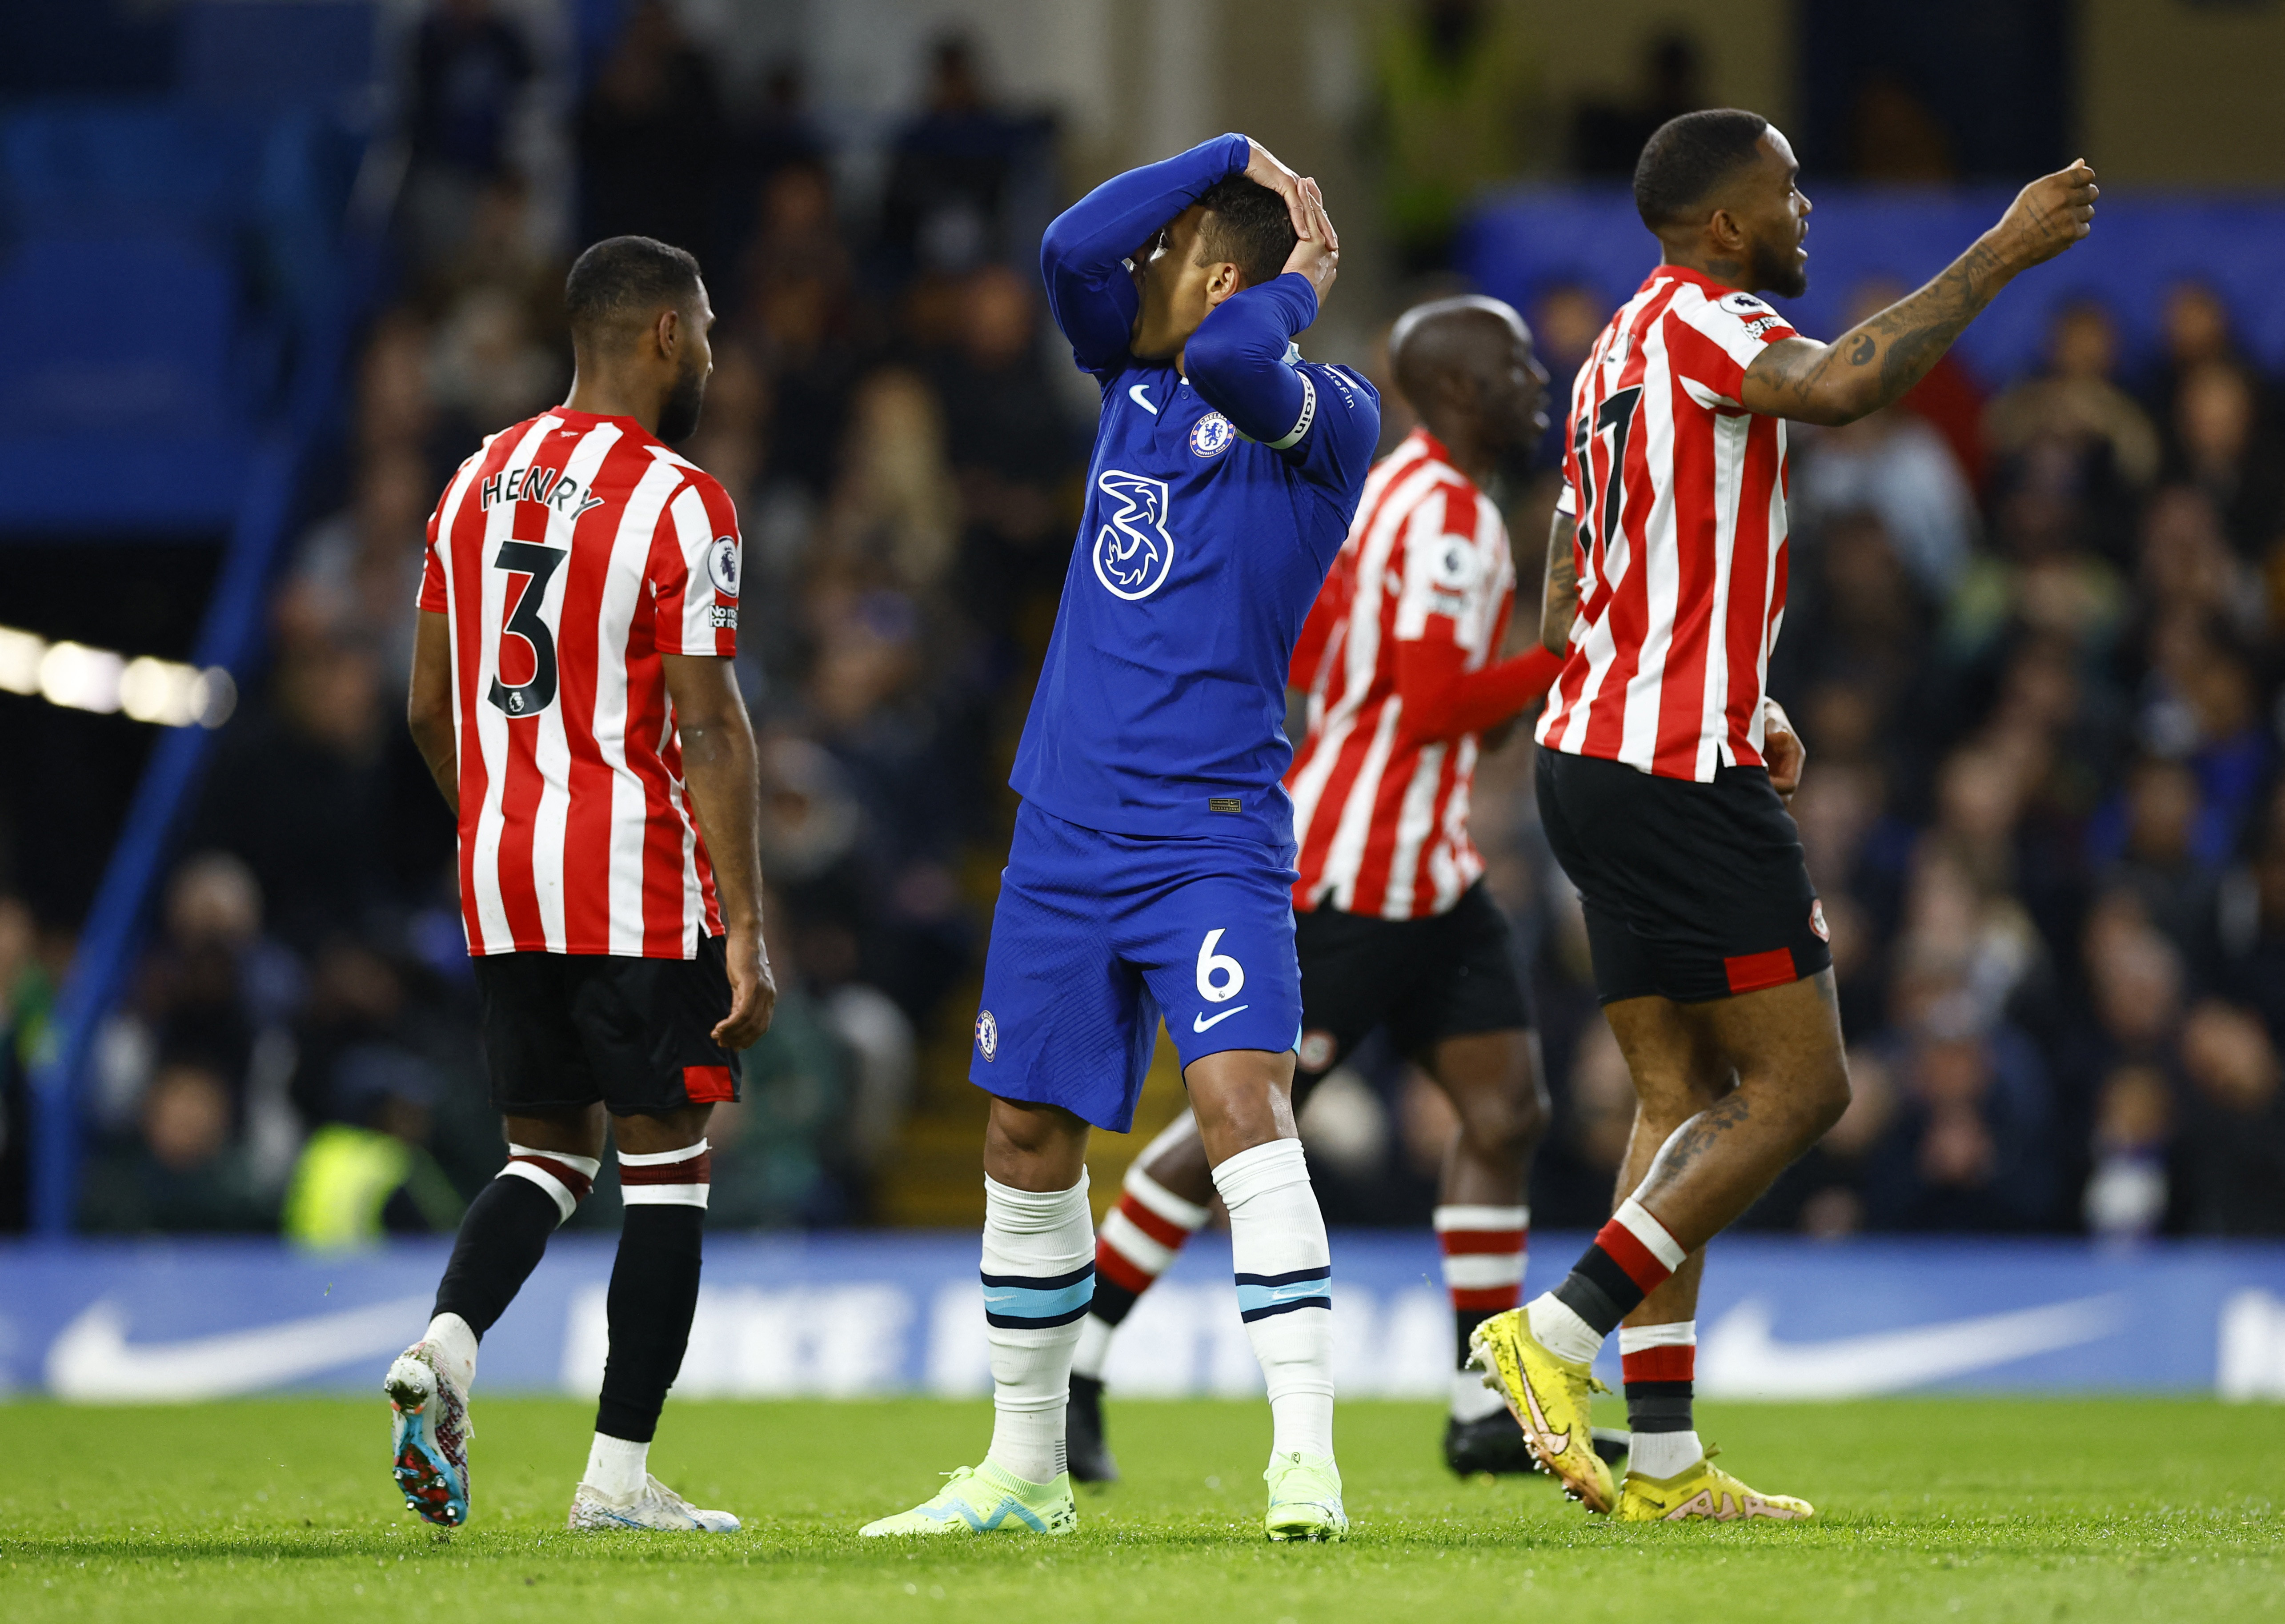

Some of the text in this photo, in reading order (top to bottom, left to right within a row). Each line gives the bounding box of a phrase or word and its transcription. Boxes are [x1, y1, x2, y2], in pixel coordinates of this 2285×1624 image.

[481, 465, 605, 521] HENRY
[487, 540, 568, 717] 3
[1196, 927, 1245, 1003] 6
